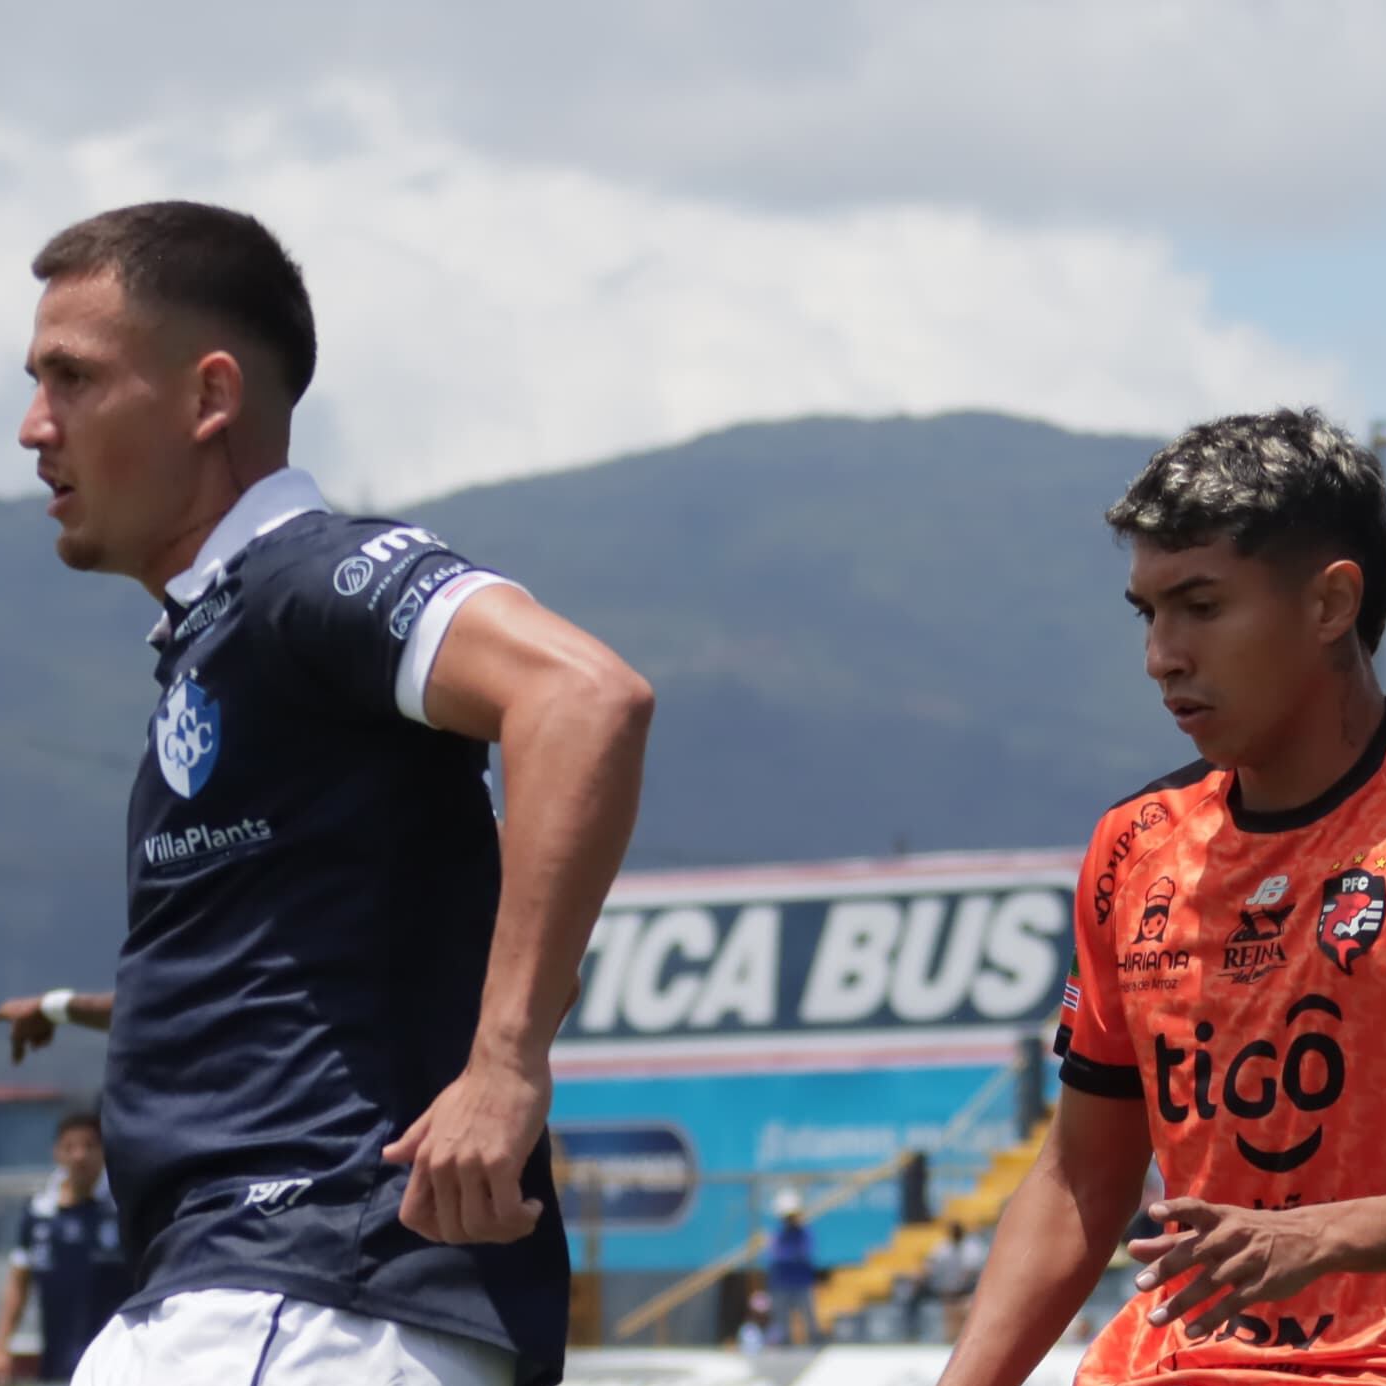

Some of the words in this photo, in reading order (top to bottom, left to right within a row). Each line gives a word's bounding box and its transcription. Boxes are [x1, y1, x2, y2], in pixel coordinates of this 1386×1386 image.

[144, 817, 273, 865] VillaPlants
[1341, 875, 1370, 894] PFC
[798, 891, 1069, 1022] BUS
[1222, 940, 1288, 971] REINA
